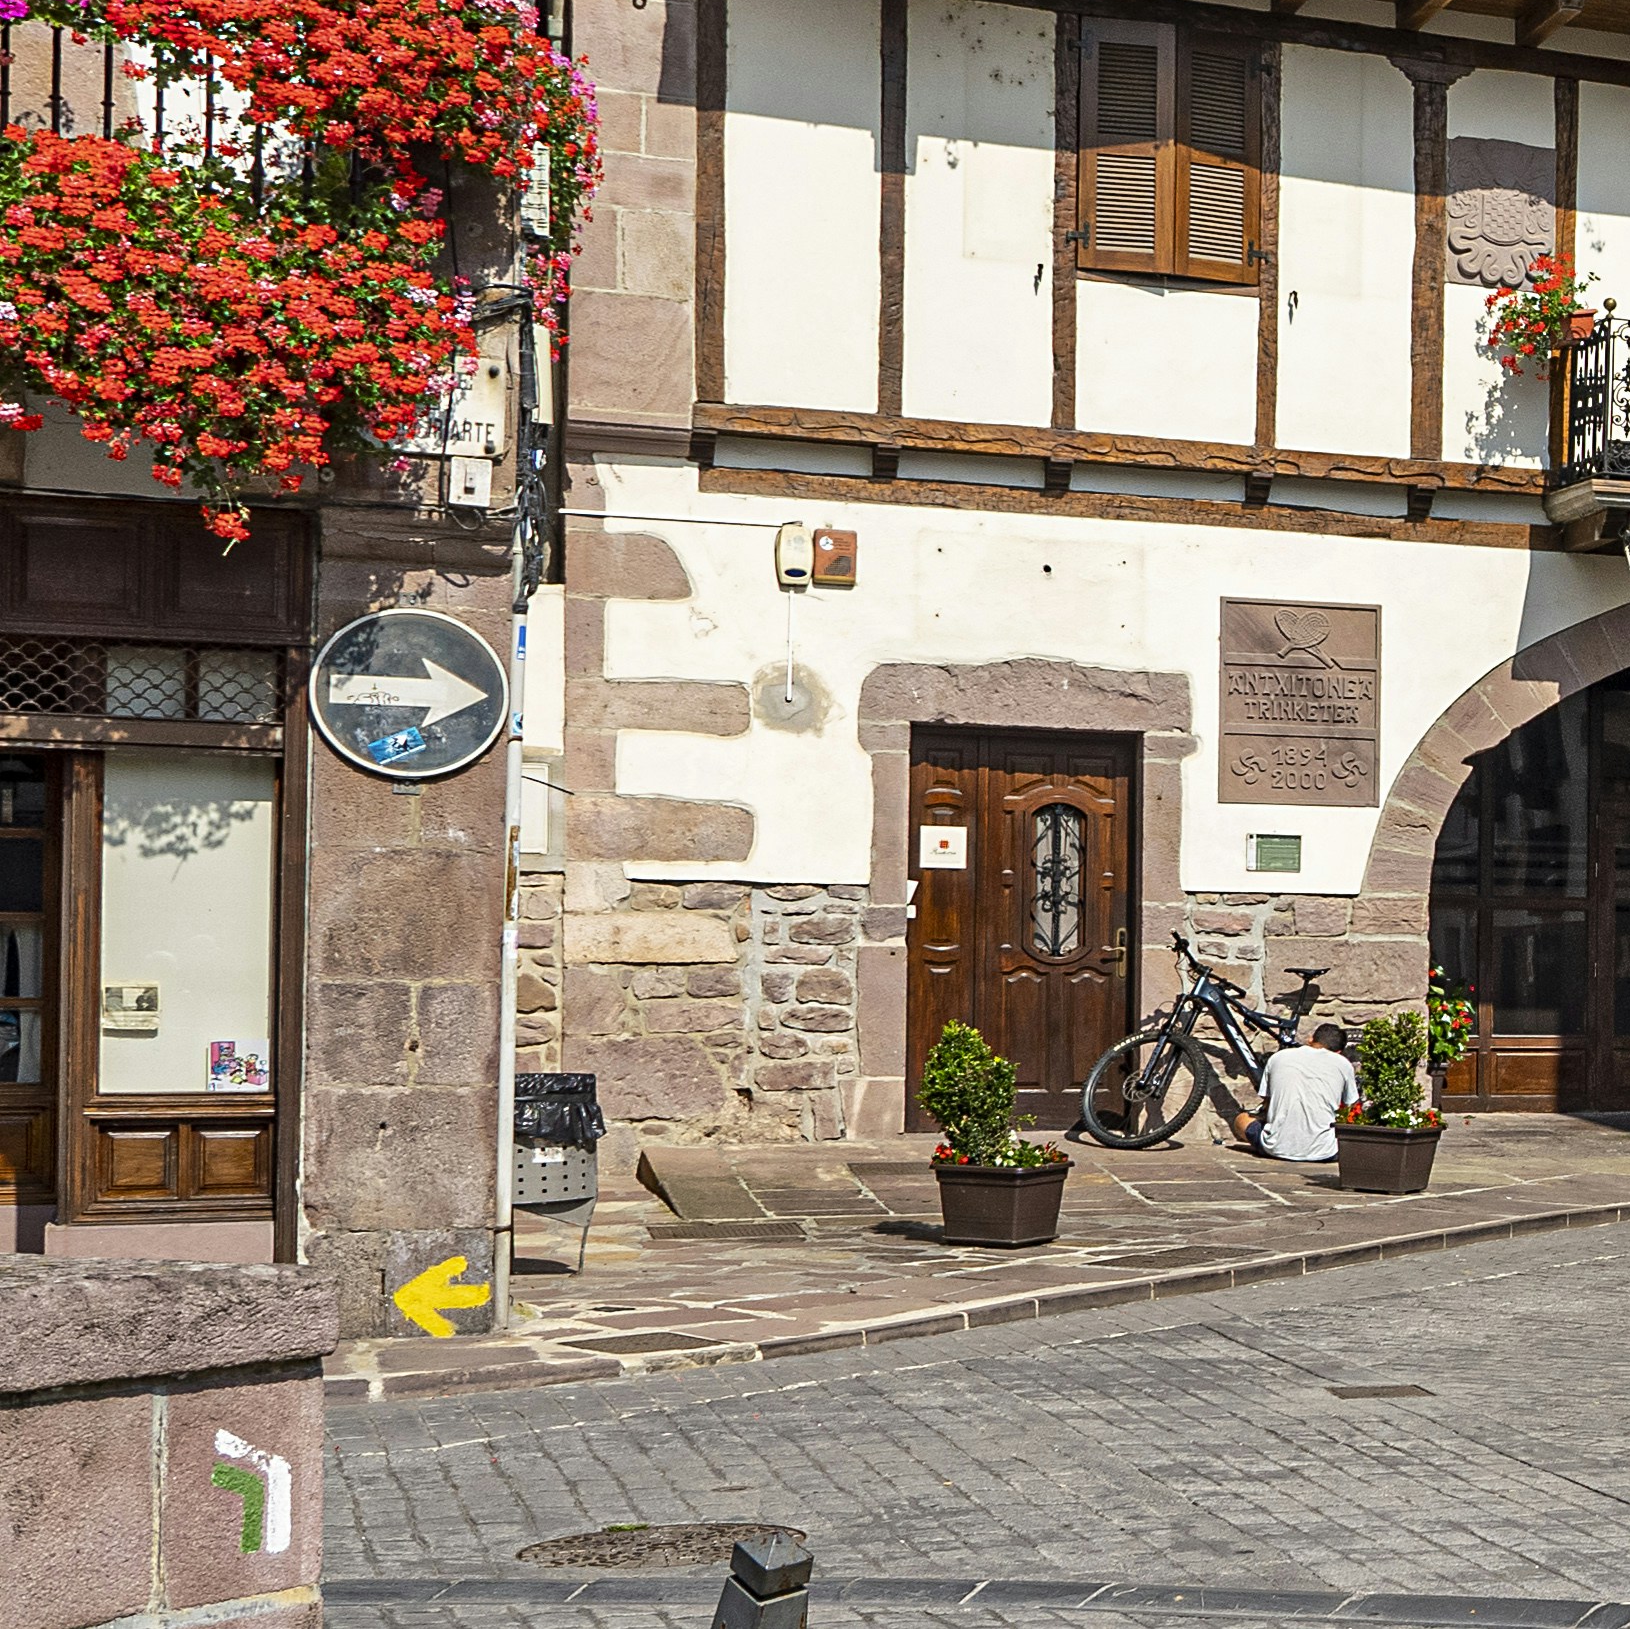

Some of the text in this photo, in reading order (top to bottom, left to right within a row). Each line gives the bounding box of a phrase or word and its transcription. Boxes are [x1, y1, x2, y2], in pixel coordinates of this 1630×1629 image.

[1228, 670, 1373, 701] ANTXITONEA
[1244, 698, 1360, 724] TRINKETEA
[1271, 747, 1328, 767] 1894
[1271, 770, 1327, 791] 2000
